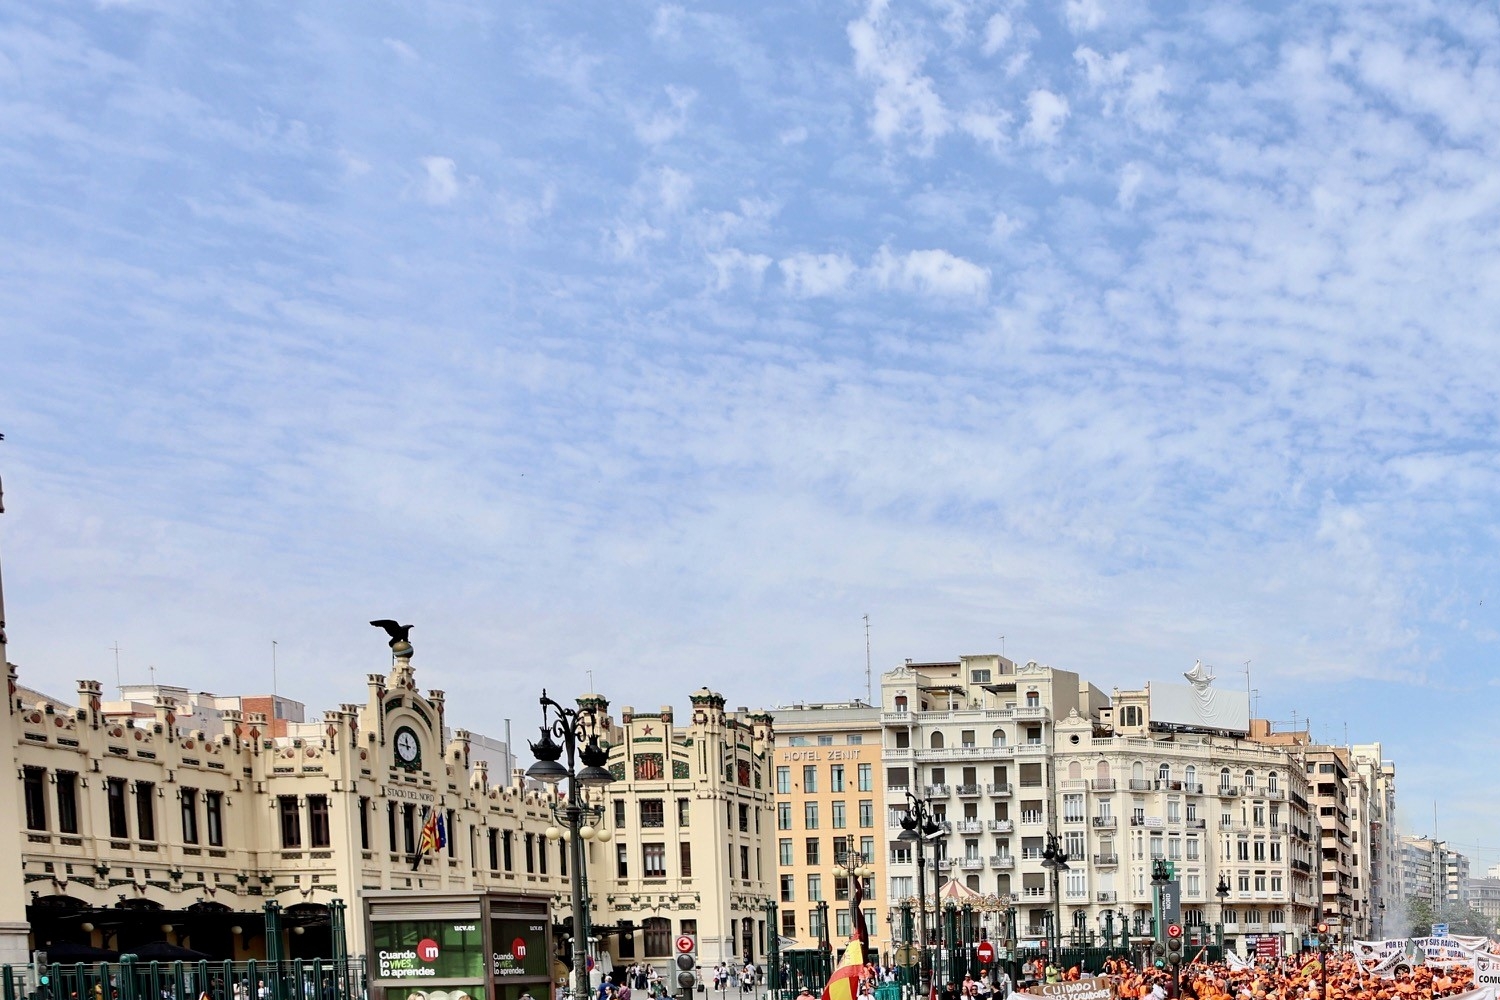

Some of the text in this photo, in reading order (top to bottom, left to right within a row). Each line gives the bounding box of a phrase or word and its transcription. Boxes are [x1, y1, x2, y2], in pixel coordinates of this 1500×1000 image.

[784, 750, 861, 762] HOTEL ZENIT
[379, 950, 416, 959] Cuando
[493, 952, 515, 960] Cuando
[380, 959, 389, 968] lo
[380, 967, 436, 979] lo aprendes
[500, 967, 525, 976] aprendes
